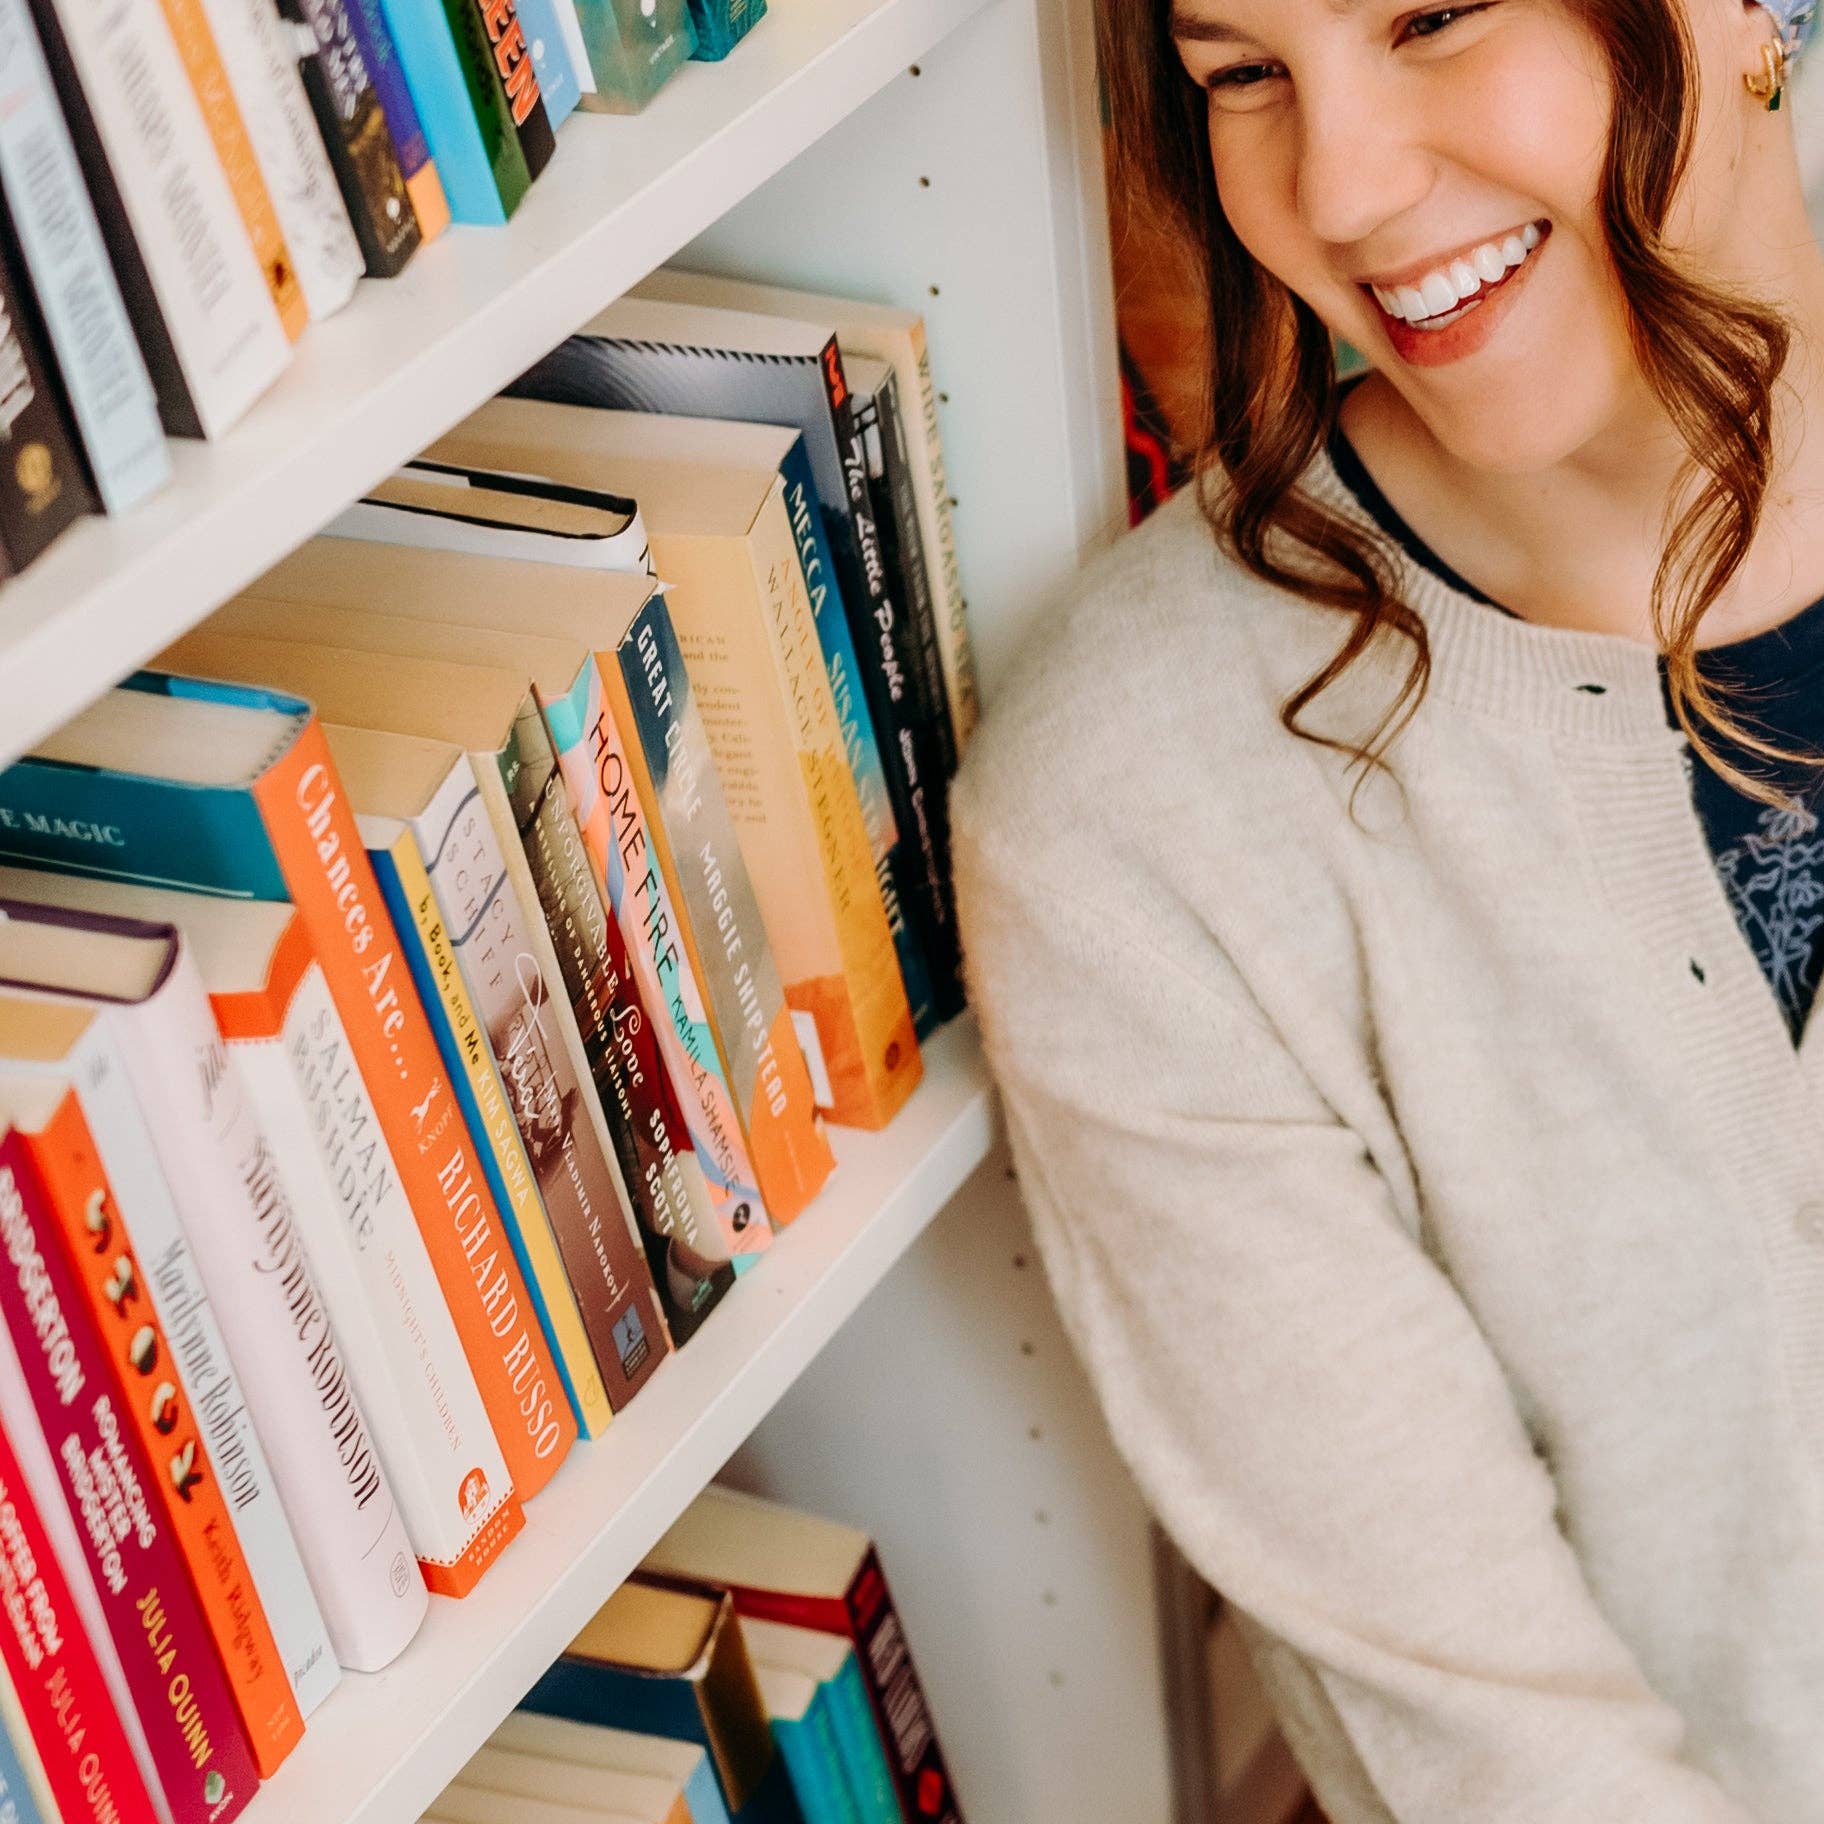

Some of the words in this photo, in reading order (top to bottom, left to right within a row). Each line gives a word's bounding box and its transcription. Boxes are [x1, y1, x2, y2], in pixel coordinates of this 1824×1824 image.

[788, 481, 830, 618] MECCA
[827, 651, 864, 774] SUSAN
[844, 438, 863, 504] The
[855, 510, 884, 599] Little
[873, 605, 904, 704] People
[25, 811, 126, 848] MAGIC
[295, 762, 375, 956] Chances
[360, 950, 409, 1081] Are...
[445, 841, 505, 989] SCHIFF
[461, 816, 515, 946] STACY
[637, 623, 674, 719] GREAT
[664, 719, 703, 825] CIRCLE
[698, 840, 745, 964] MAGGIE
[732, 963, 789, 1119] SHIPSTEAD
[533, 816, 567, 914] RETELLING
[564, 915, 577, 941] OF
[573, 945, 609, 1044] DANGEROUS
[602, 1044, 634, 1122] LIAISONS
[545, 778, 620, 998] UNFORGIVABLE
[611, 1004, 646, 1090] Love
[589, 711, 648, 875] HOME
[633, 871, 681, 988] FIRE
[671, 991, 707, 1094] KAMILA
[699, 1088, 741, 1200] SHAMSIE
[309, 1006, 394, 1208] SALMAN
[416, 1101, 454, 1157] KNOPF
[428, 924, 453, 993] Book,
[450, 991, 468, 1032] and
[463, 1028, 481, 1067] Me
[477, 1072, 499, 1121] KIM
[493, 1120, 530, 1208] SAGWA
[643, 1160, 676, 1237] SCOTT
[647, 1106, 699, 1248] SOPHFRONIA
[153, 1236, 219, 1384] Marilynne
[200, 1374, 263, 1515] Robinson
[238, 1135, 322, 1342] Marilynne
[307, 1324, 382, 1512] Robinson
[384, 1248, 429, 1368] MIDNIGHT'S
[425, 1364, 464, 1456] CHILDREN
[436, 1145, 520, 1340] RICHARD
[501, 1326, 562, 1460] RUSSO
[59, 1431, 129, 1597] BRIDGERTON
[88, 1446, 133, 1545] MISTER
[91, 1393, 158, 1551] ROMANCING
[466, 1505, 512, 1563] RANDOM
[23, 1578, 65, 1658] FROM
[135, 1587, 173, 1677] JULIA
[167, 1672, 215, 1772] QUINN
[201, 1517, 234, 1587] Keith
[225, 1582, 265, 1686] Ridgway
[44, 1665, 88, 1756] JULIA
